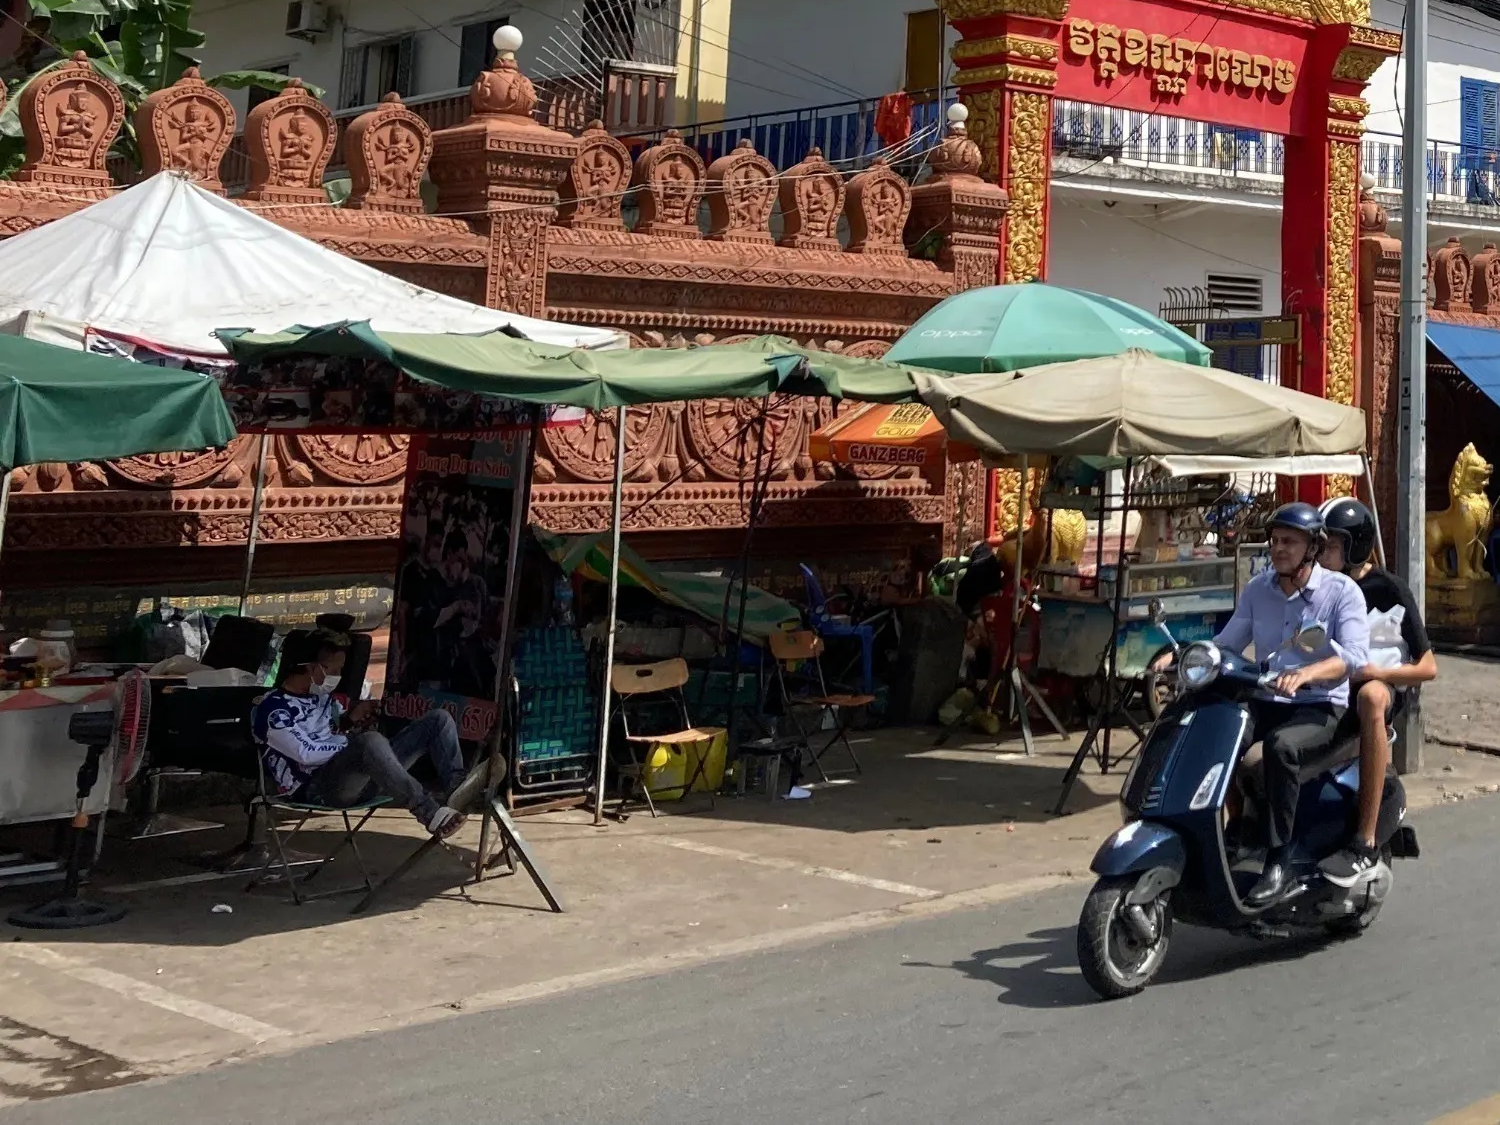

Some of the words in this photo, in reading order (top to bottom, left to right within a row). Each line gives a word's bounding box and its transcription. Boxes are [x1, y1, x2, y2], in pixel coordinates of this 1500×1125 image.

[892, 408, 931, 419] BEER
[876, 426, 916, 436] GOLD
[849, 444, 926, 464] GANZBERG
